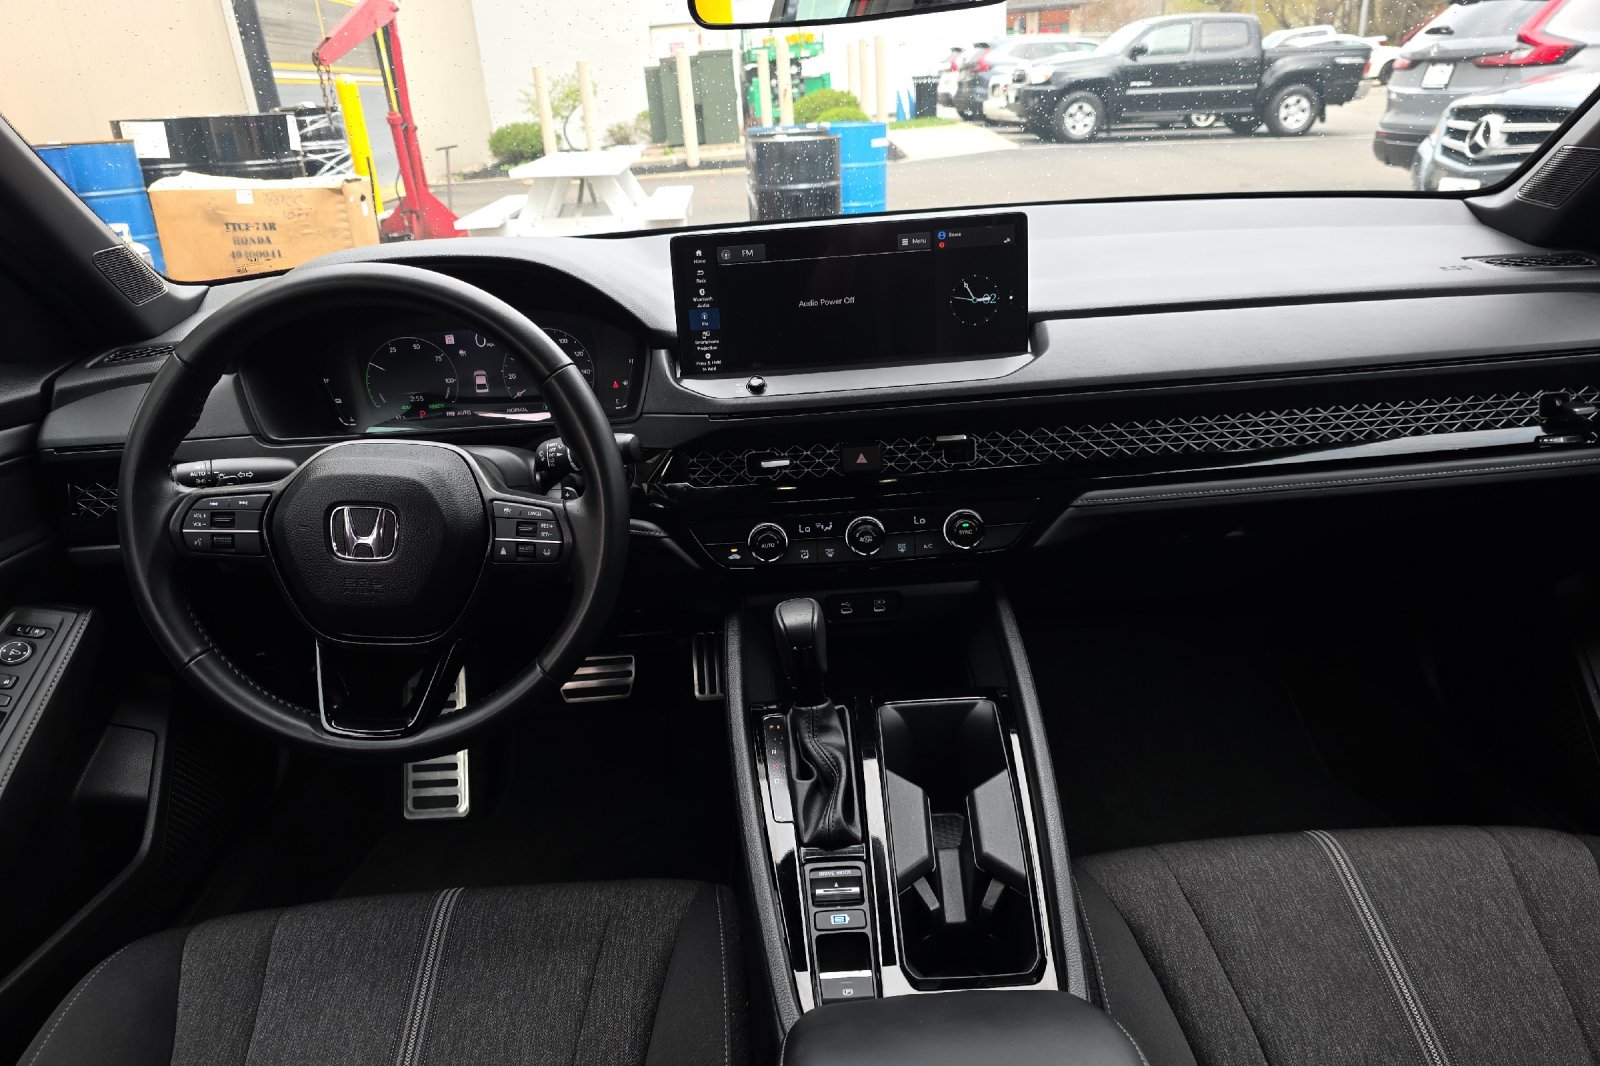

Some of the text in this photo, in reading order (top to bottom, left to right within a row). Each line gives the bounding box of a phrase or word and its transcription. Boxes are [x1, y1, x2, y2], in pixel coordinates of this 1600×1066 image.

[232, 235, 272, 245] HONDA
[741, 249, 754, 257] FM
[820, 298, 842, 306] Power
[843, 296, 855, 304] Off
[913, 516, 926, 525] Lo
[798, 524, 811, 533] Lo
